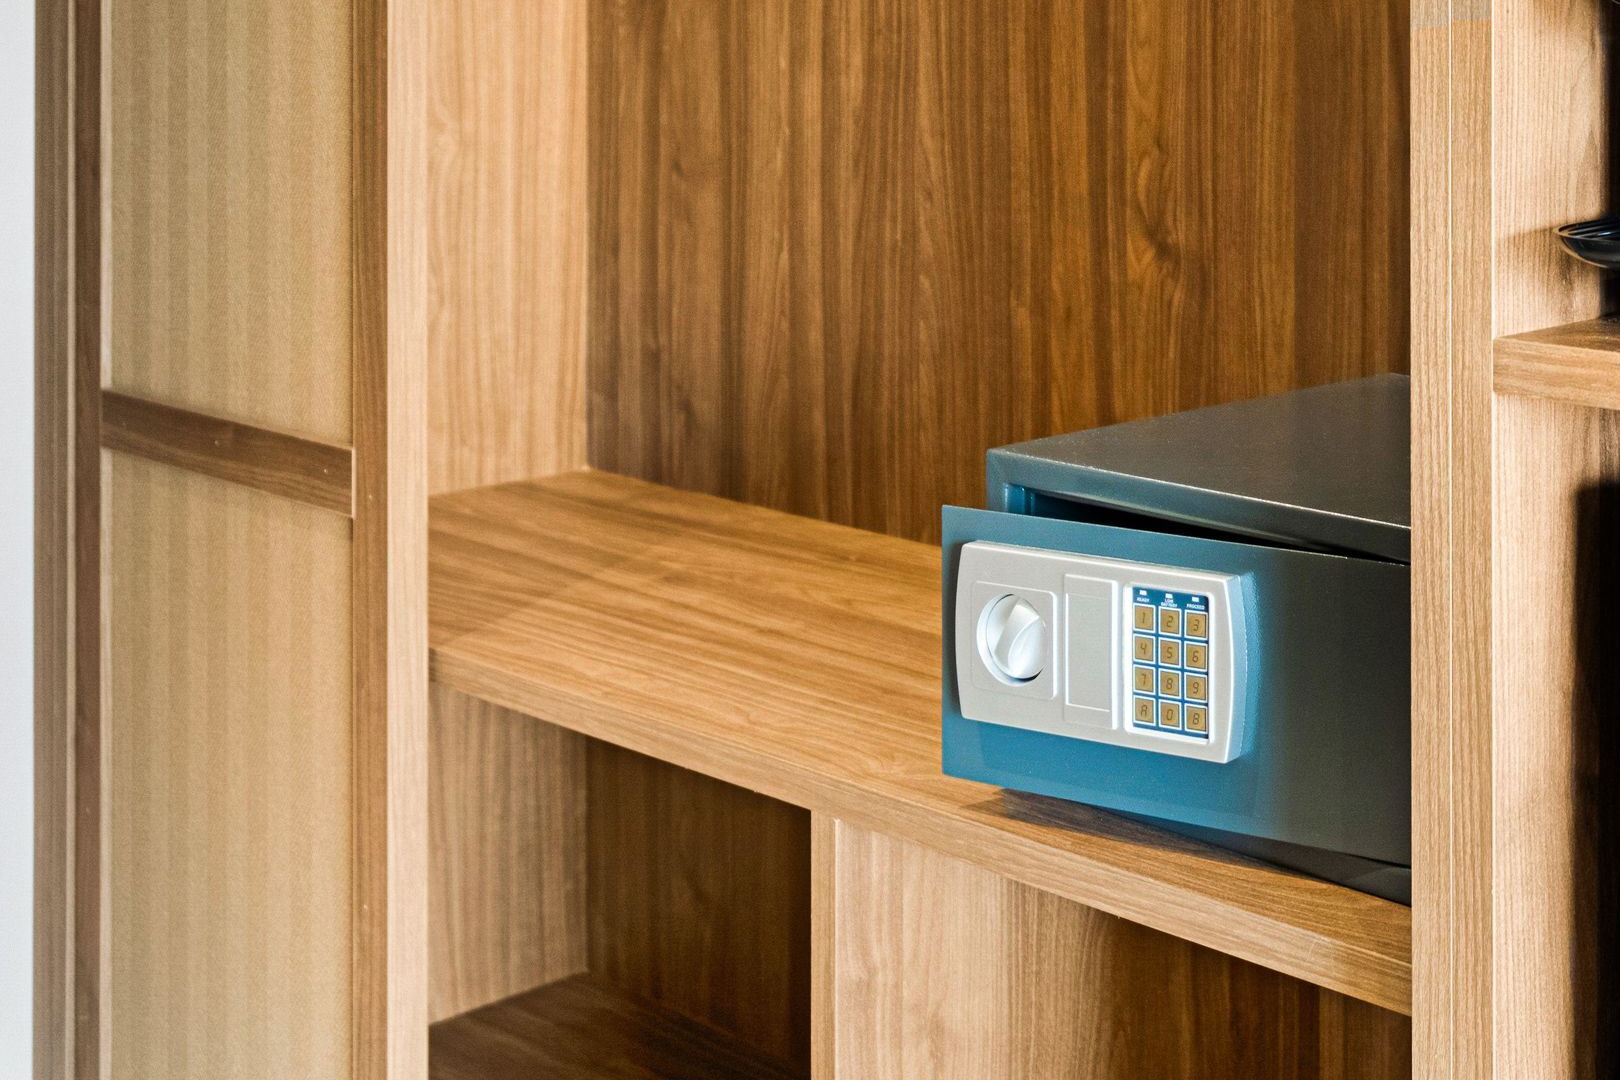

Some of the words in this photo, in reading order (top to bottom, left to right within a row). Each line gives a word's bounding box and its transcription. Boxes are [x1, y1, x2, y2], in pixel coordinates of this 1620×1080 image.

[1166, 615, 1174, 628] 2
[1193, 618, 1200, 632] 3
[1140, 642, 1147, 655] 4
[1166, 646, 1173, 659] 5
[1192, 649, 1199, 663] 6
[1141, 673, 1147, 687] 7
[1166, 677, 1173, 690] 8
[1192, 681, 1200, 694] 9
